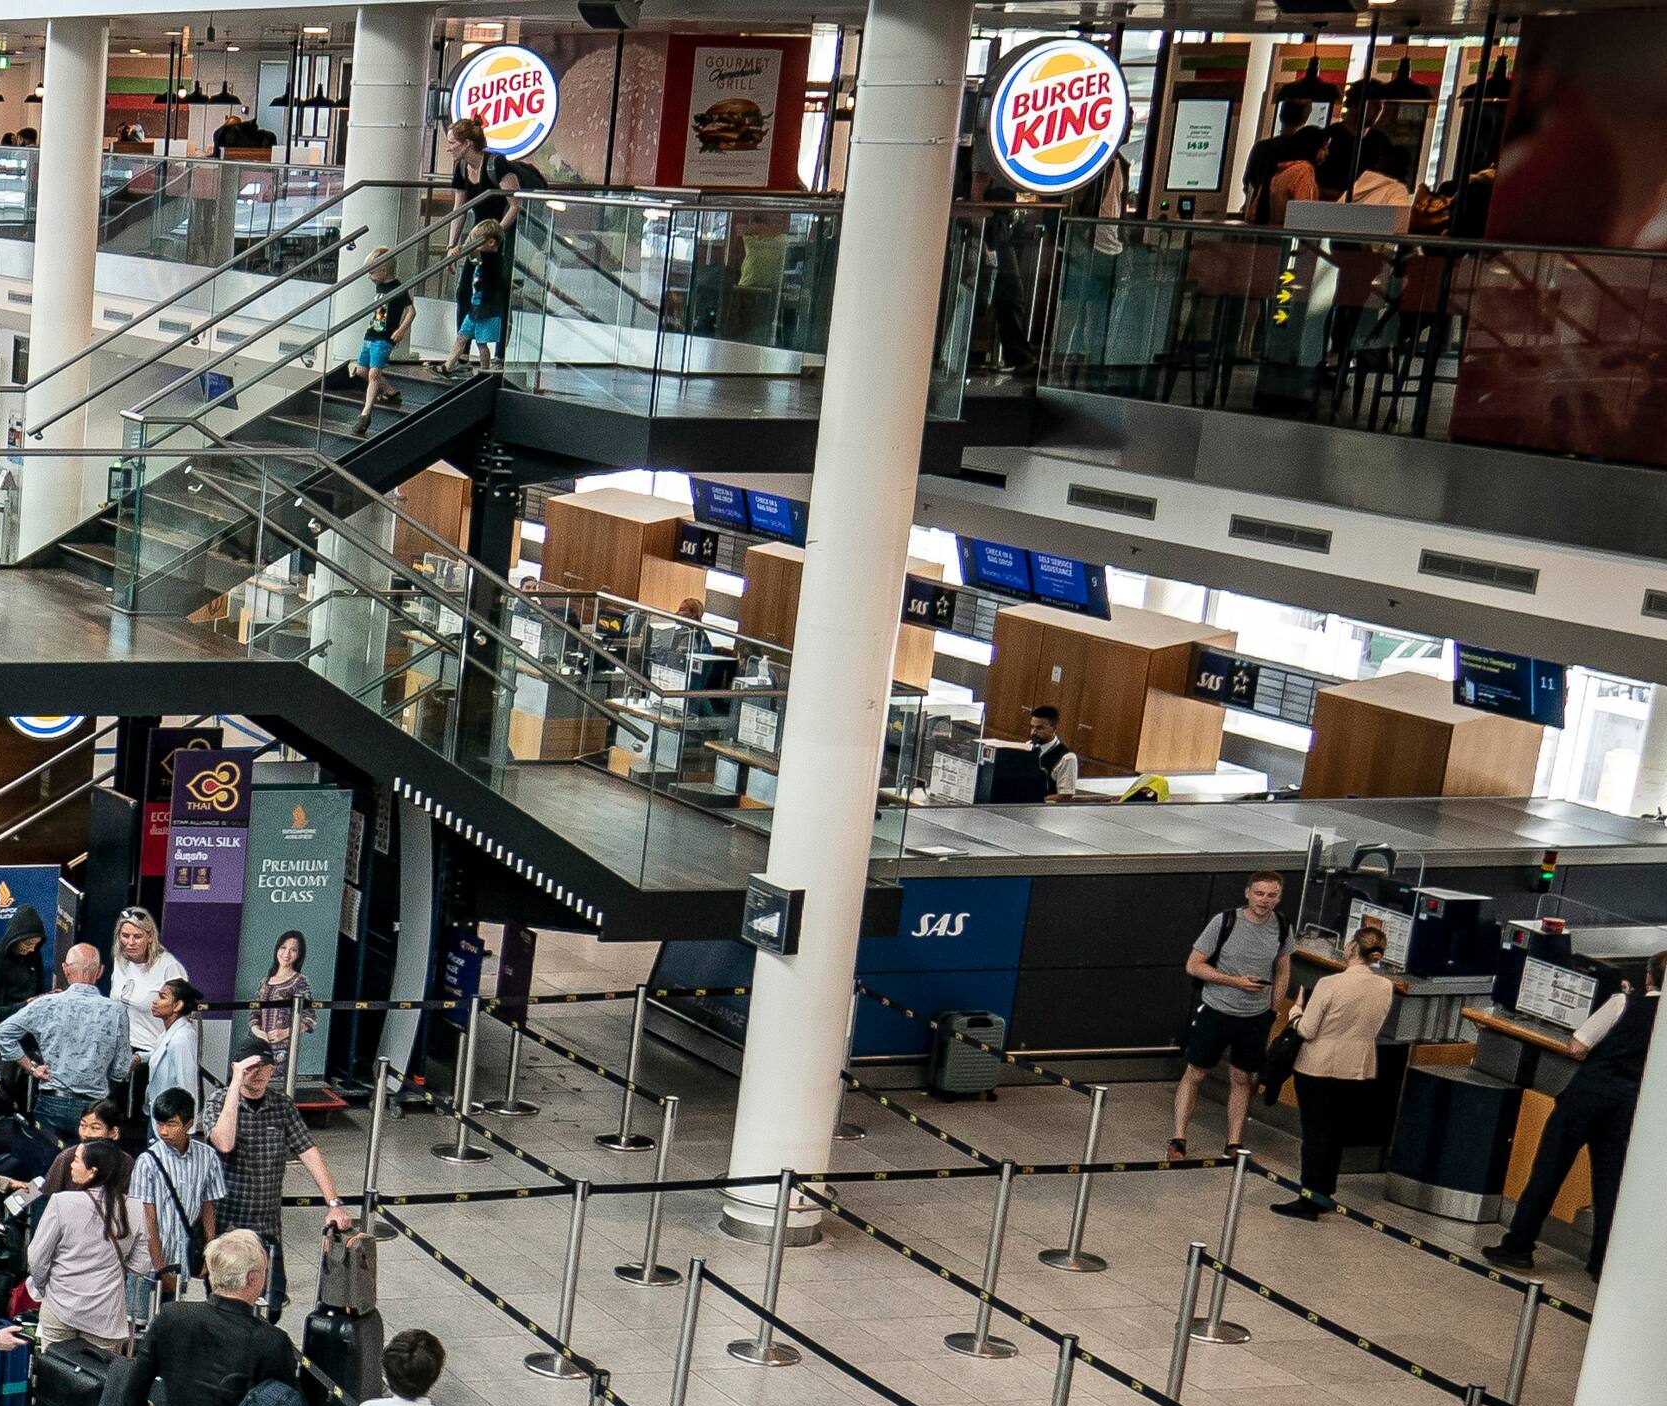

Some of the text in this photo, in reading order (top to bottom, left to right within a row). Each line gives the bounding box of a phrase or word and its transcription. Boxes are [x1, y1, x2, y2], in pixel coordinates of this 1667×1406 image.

[705, 55, 771, 69] GOURMET
[467, 70, 543, 106] BURGER
[715, 78, 756, 91] GRILL
[1012, 72, 1110, 120] BURGER
[470, 88, 546, 130] KING
[1009, 96, 1113, 156] KING
[793, 510, 799, 521] 7
[680, 540, 698, 556] SAS
[984, 546, 1001, 557] CHECK
[998, 557, 1014, 567] DROP
[1091, 577, 1098, 588] 9
[907, 598, 930, 616] SAS
[1196, 670, 1225, 692] SAS
[1540, 676, 1556, 690] 11
[187, 801, 212, 811] THAI
[175, 836, 242, 848] ROYAL SILK
[261, 858, 330, 873] PREMIUM
[257, 874, 332, 888] ECONOMY
[270, 889, 315, 903] CLASS
[911, 913, 970, 937] SAS
